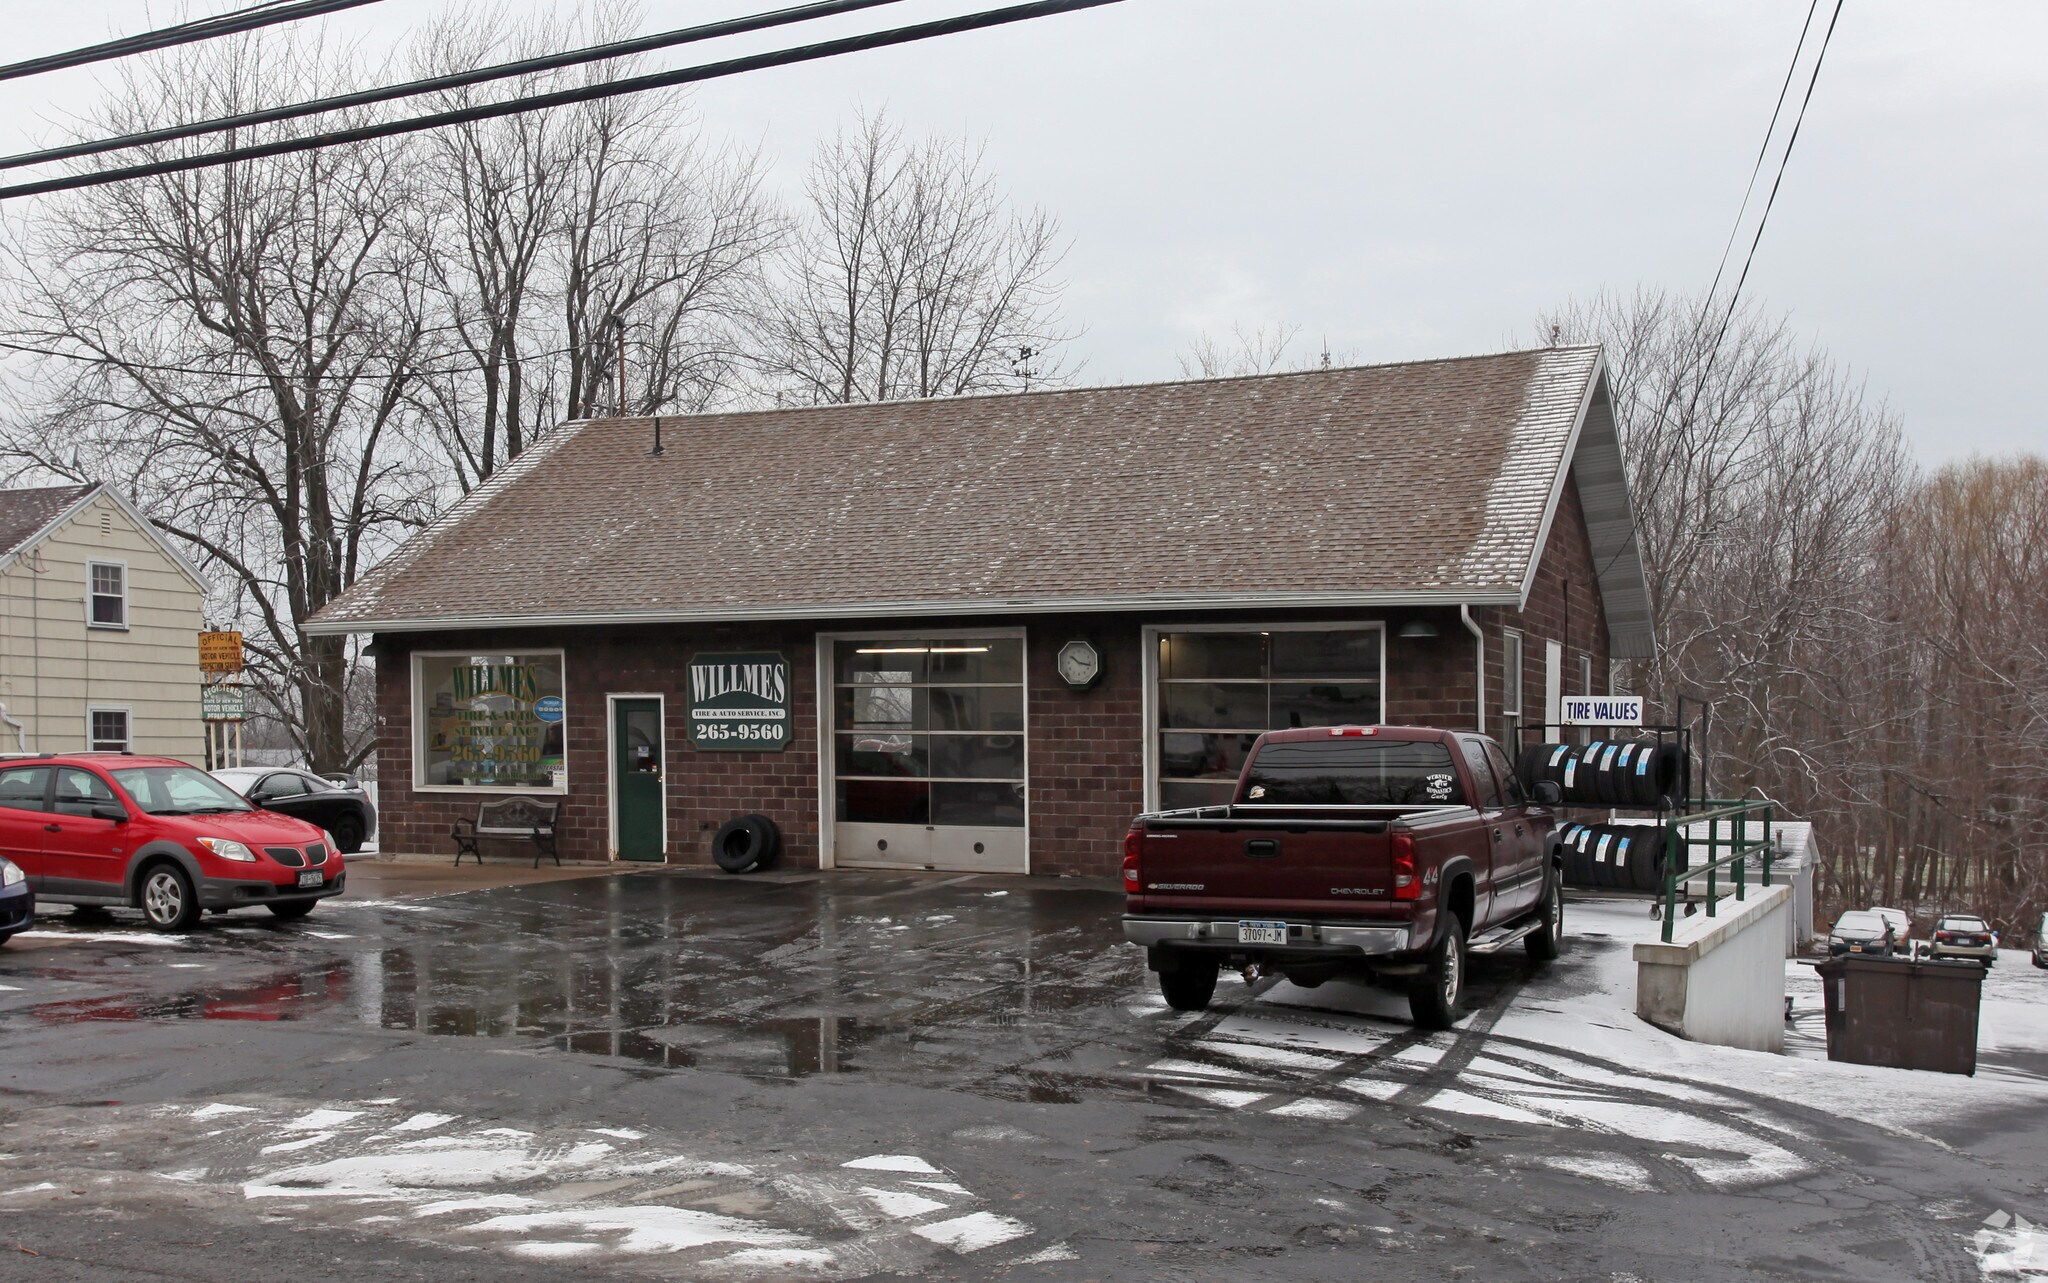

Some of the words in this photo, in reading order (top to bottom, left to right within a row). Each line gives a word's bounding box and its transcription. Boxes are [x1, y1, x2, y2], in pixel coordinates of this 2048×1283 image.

[202, 634, 238, 645] OFFICIAL
[201, 652, 217, 660] MOTOR
[219, 652, 240, 660] VEHICLE
[452, 665, 538, 703] WILLMES
[691, 663, 785, 704] WILLMES
[203, 684, 242, 698] REGISTERED
[204, 704, 220, 712] MOTOR
[221, 704, 244, 712] VEHICLE
[1567, 702, 1590, 719] TIRE
[1594, 702, 1638, 720] VALUES
[456, 710, 487, 721] TIRE
[503, 710, 535, 721] AUTO
[696, 723, 784, 740] 265-9560
[450, 744, 542, 763] 265-9560
[1426, 774, 1452, 782] WEBSTER
[1330, 887, 1385, 895] CHEVROLET
